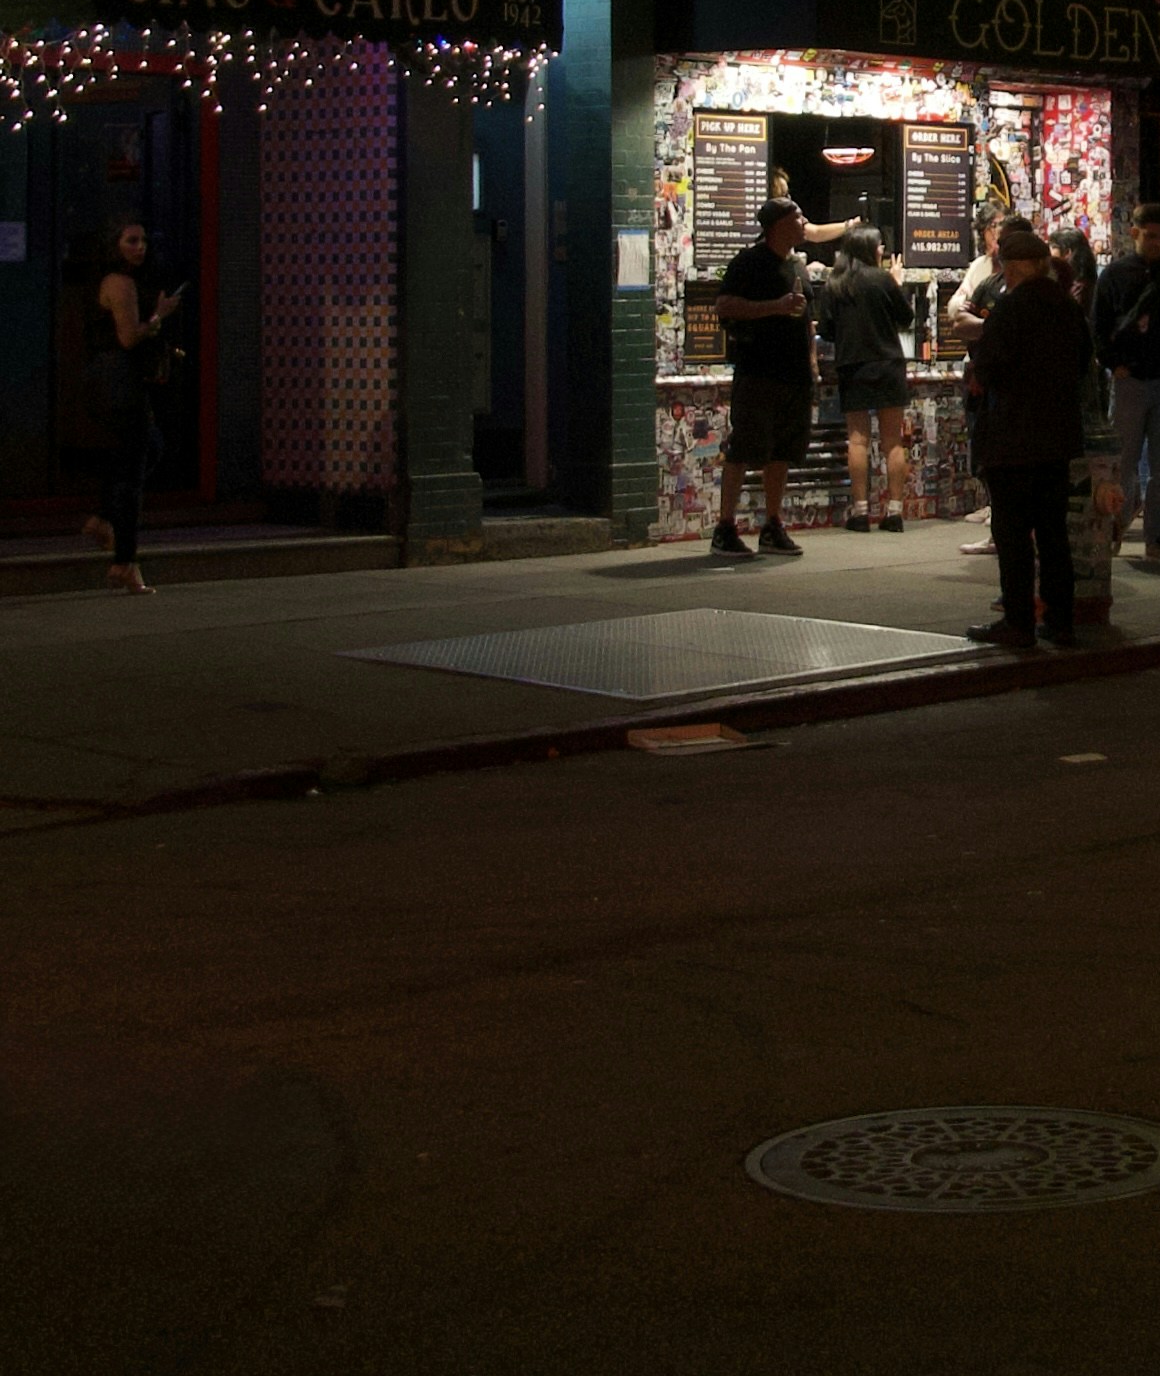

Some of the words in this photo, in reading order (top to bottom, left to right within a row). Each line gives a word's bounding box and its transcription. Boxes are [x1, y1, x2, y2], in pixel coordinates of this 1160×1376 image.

[503, 2, 541, 28] 1942
[701, 120, 721, 132] PICK
[723, 121, 735, 133] UP
[737, 123, 760, 134] HERE
[912, 132, 938, 143] ORDER
[940, 133, 961, 144] HERE
[706, 143, 717, 155] By
[720, 143, 736, 154] The
[739, 143, 756, 154] Pan
[912, 152, 922, 164] By
[924, 153, 939, 163] The
[940, 153, 960, 164] Slice
[913, 230, 936, 239] ORDER
